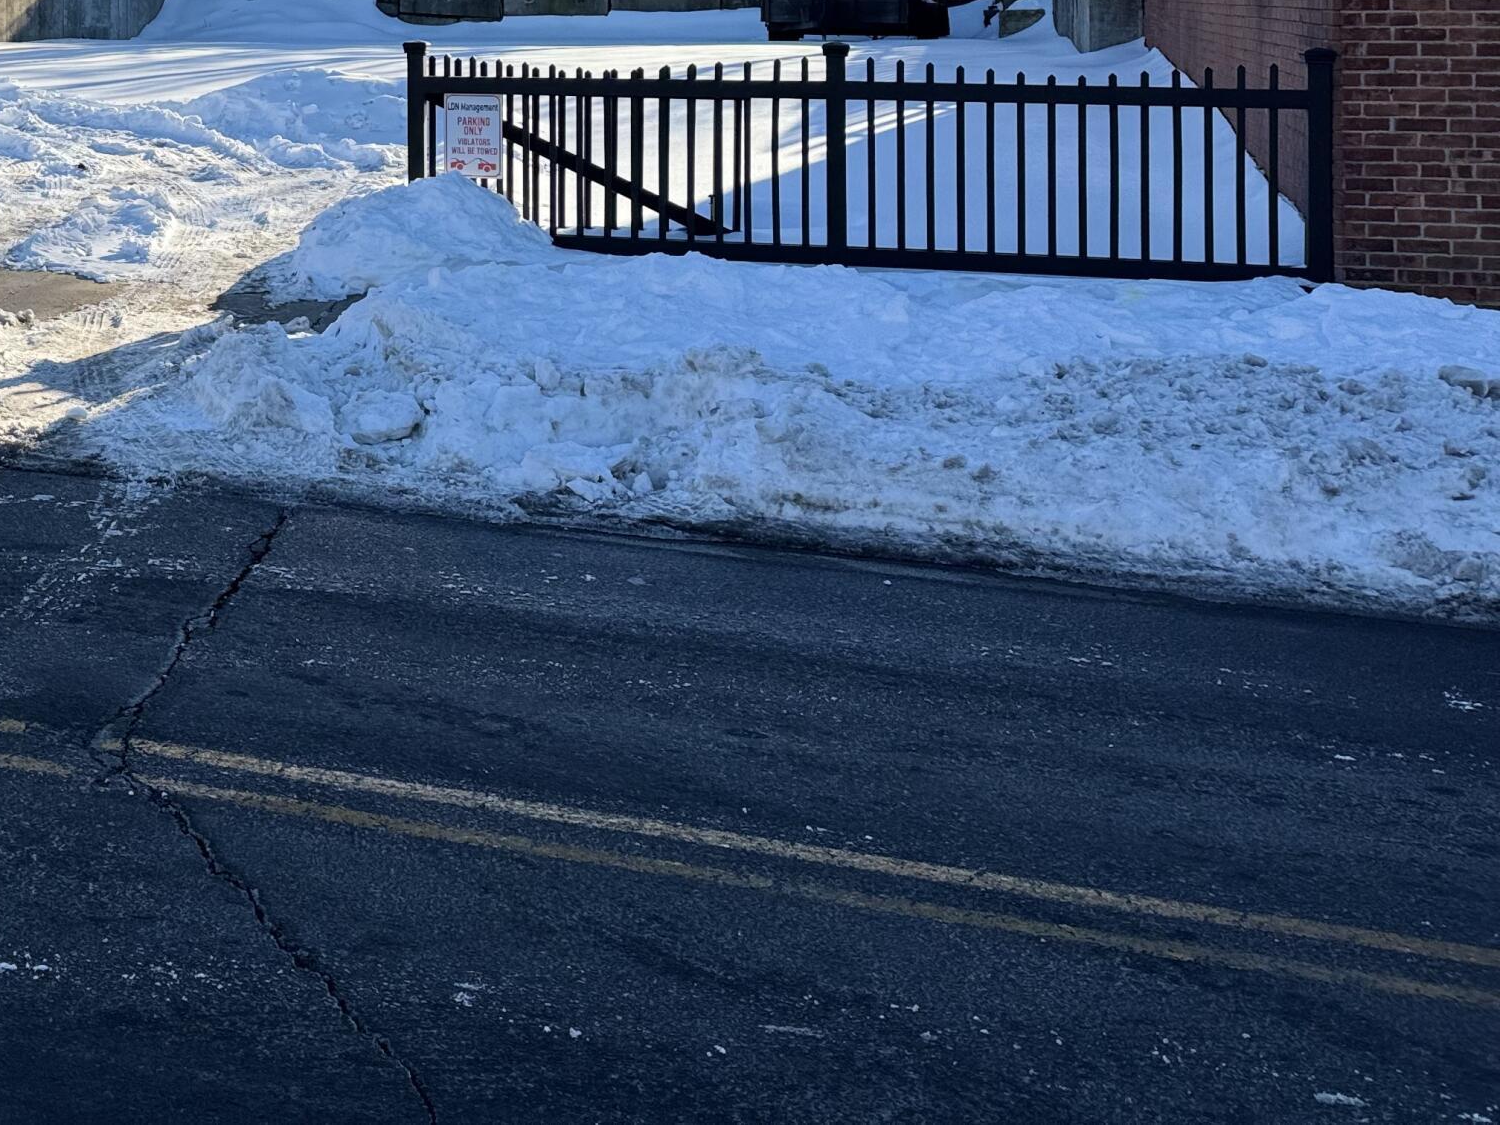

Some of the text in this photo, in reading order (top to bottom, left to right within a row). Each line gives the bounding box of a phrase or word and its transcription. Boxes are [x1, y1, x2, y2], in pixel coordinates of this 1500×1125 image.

[448, 102, 498, 113] LDN Management
[457, 117, 490, 126] PARKING
[464, 127, 483, 135] ONLY
[477, 147, 498, 155] TOWED
